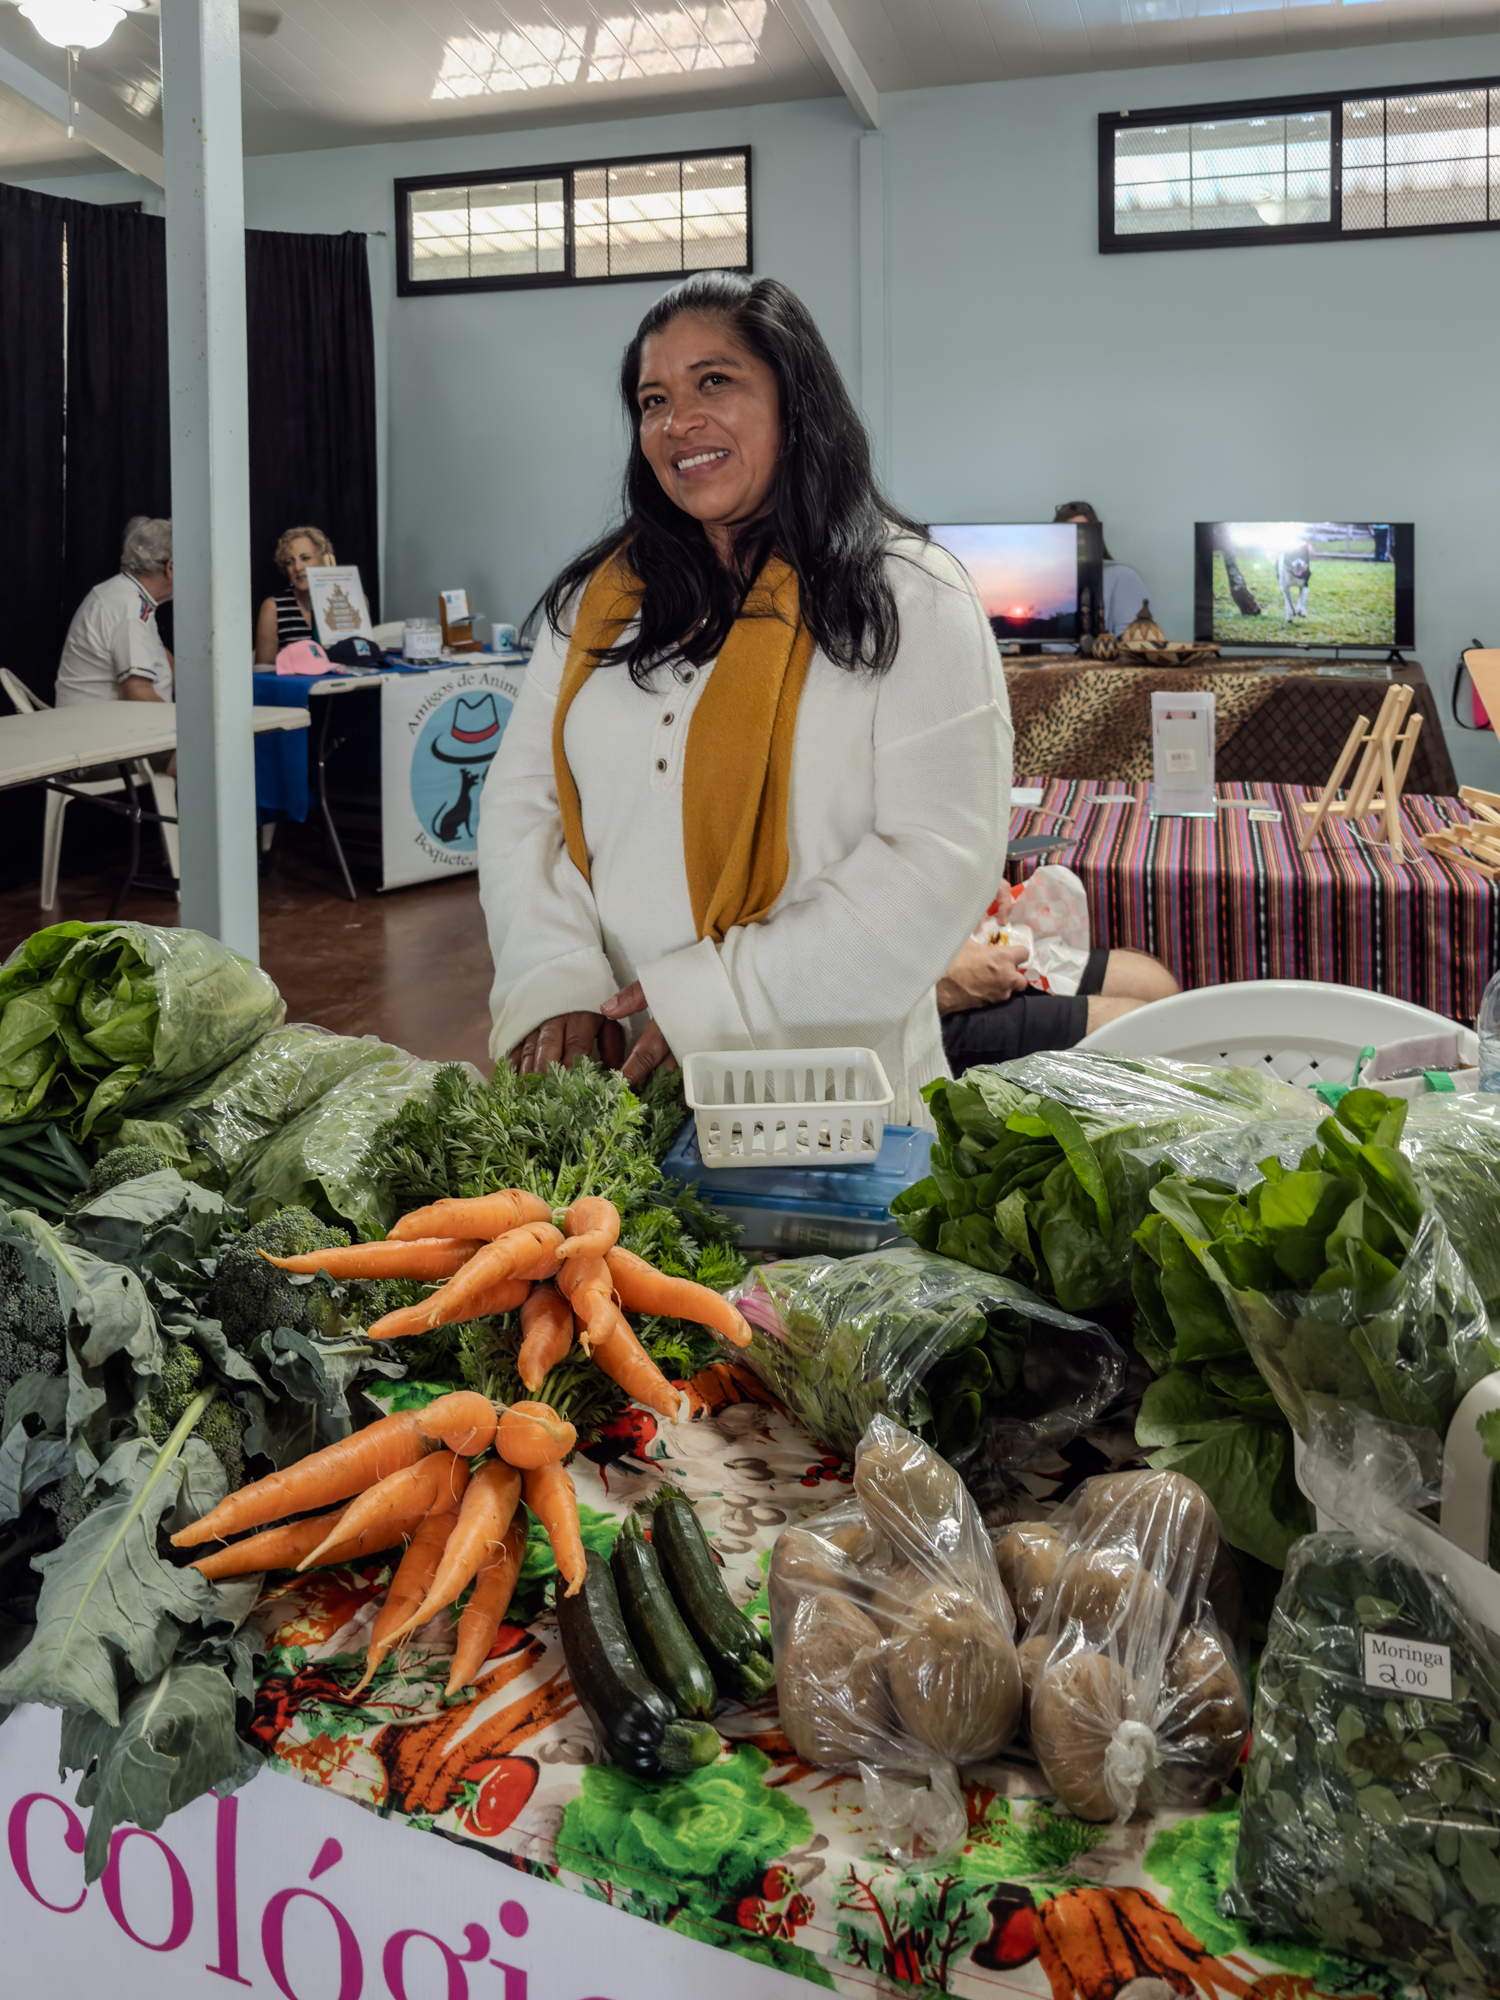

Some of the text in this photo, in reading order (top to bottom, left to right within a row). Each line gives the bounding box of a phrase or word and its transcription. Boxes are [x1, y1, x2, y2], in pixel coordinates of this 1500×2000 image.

[407, 672, 519, 735] Amigos de Anim
[414, 831, 473, 867] Boquete,
[1372, 1639, 1444, 1669] Moringa
[1379, 1664, 1428, 1689] 2.00
